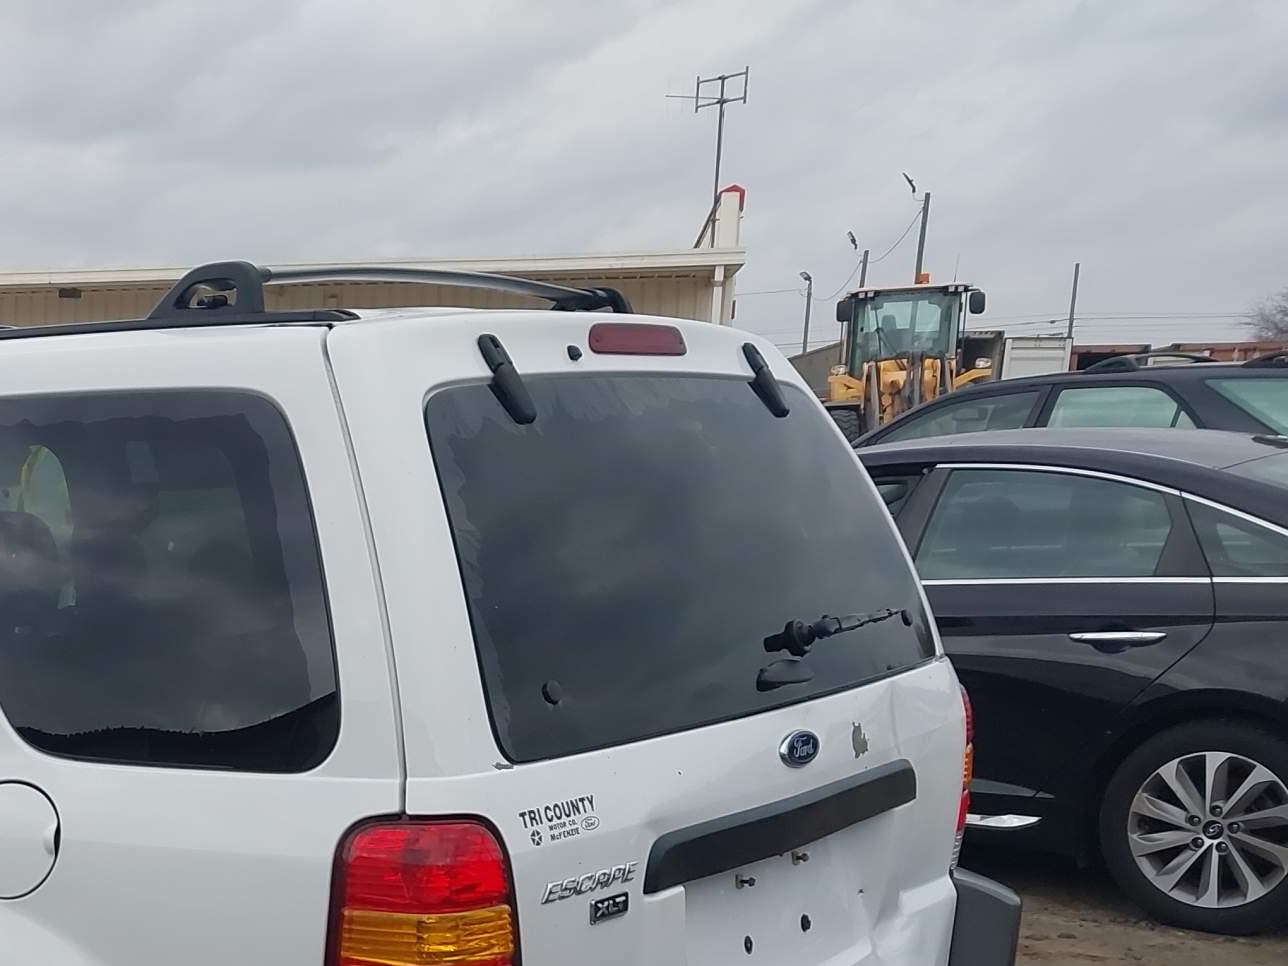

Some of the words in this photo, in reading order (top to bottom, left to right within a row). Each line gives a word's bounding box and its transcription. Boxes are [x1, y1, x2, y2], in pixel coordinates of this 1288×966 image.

[519, 808, 544, 829] TRI
[544, 795, 595, 823] COUNTY
[549, 821, 567, 831] MOTOR
[541, 861, 638, 905] ESCAPE
[596, 896, 627, 917] XLT
